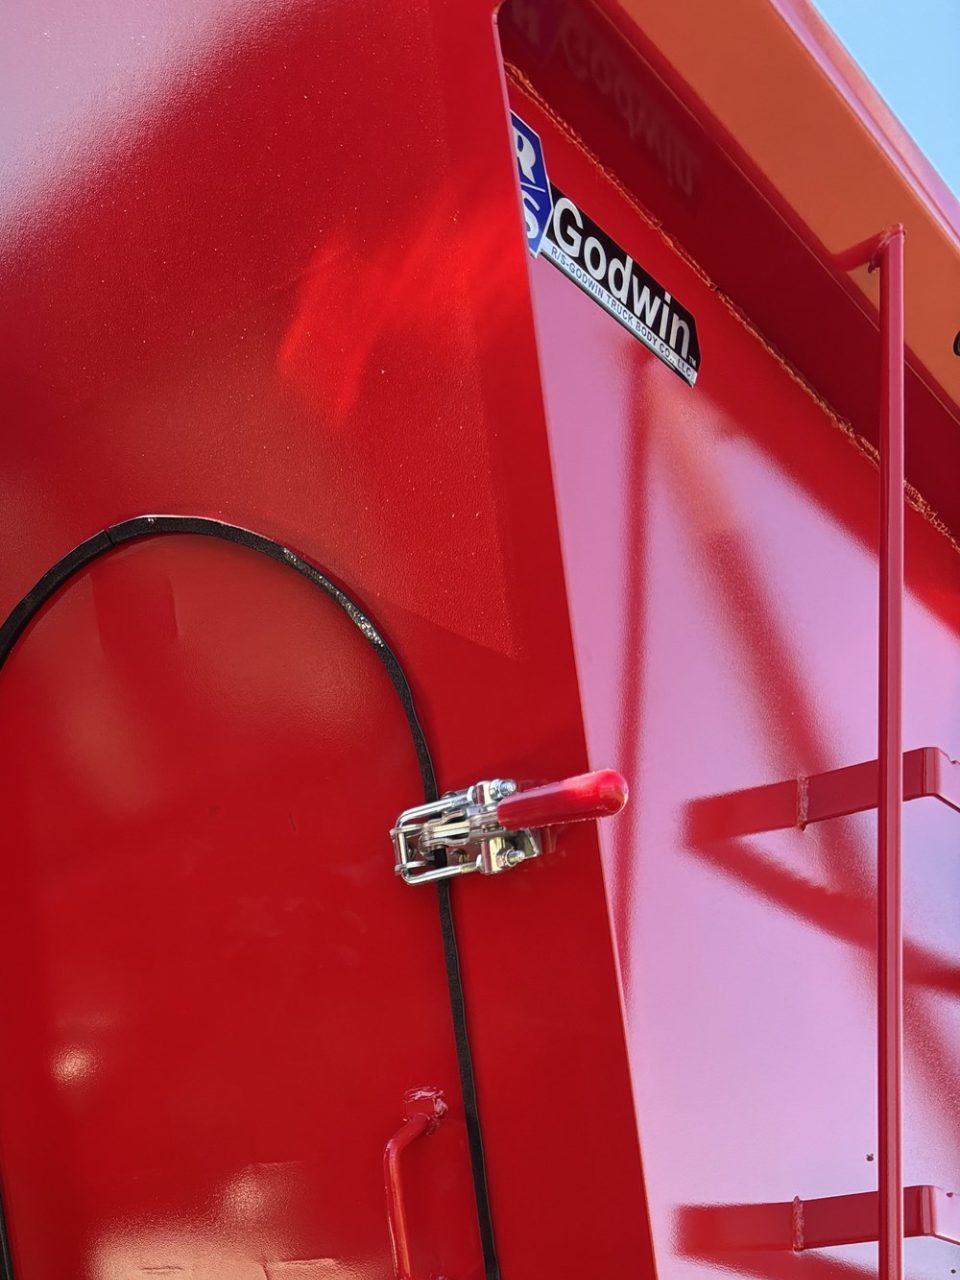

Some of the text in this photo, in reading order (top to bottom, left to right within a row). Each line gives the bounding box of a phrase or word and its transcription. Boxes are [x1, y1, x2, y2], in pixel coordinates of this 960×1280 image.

[551, 245, 604, 299] R/S-GODWIN
[606, 293, 634, 326] TRUCK
[635, 320, 658, 346] BODY
[553, 197, 690, 361] Godwin
